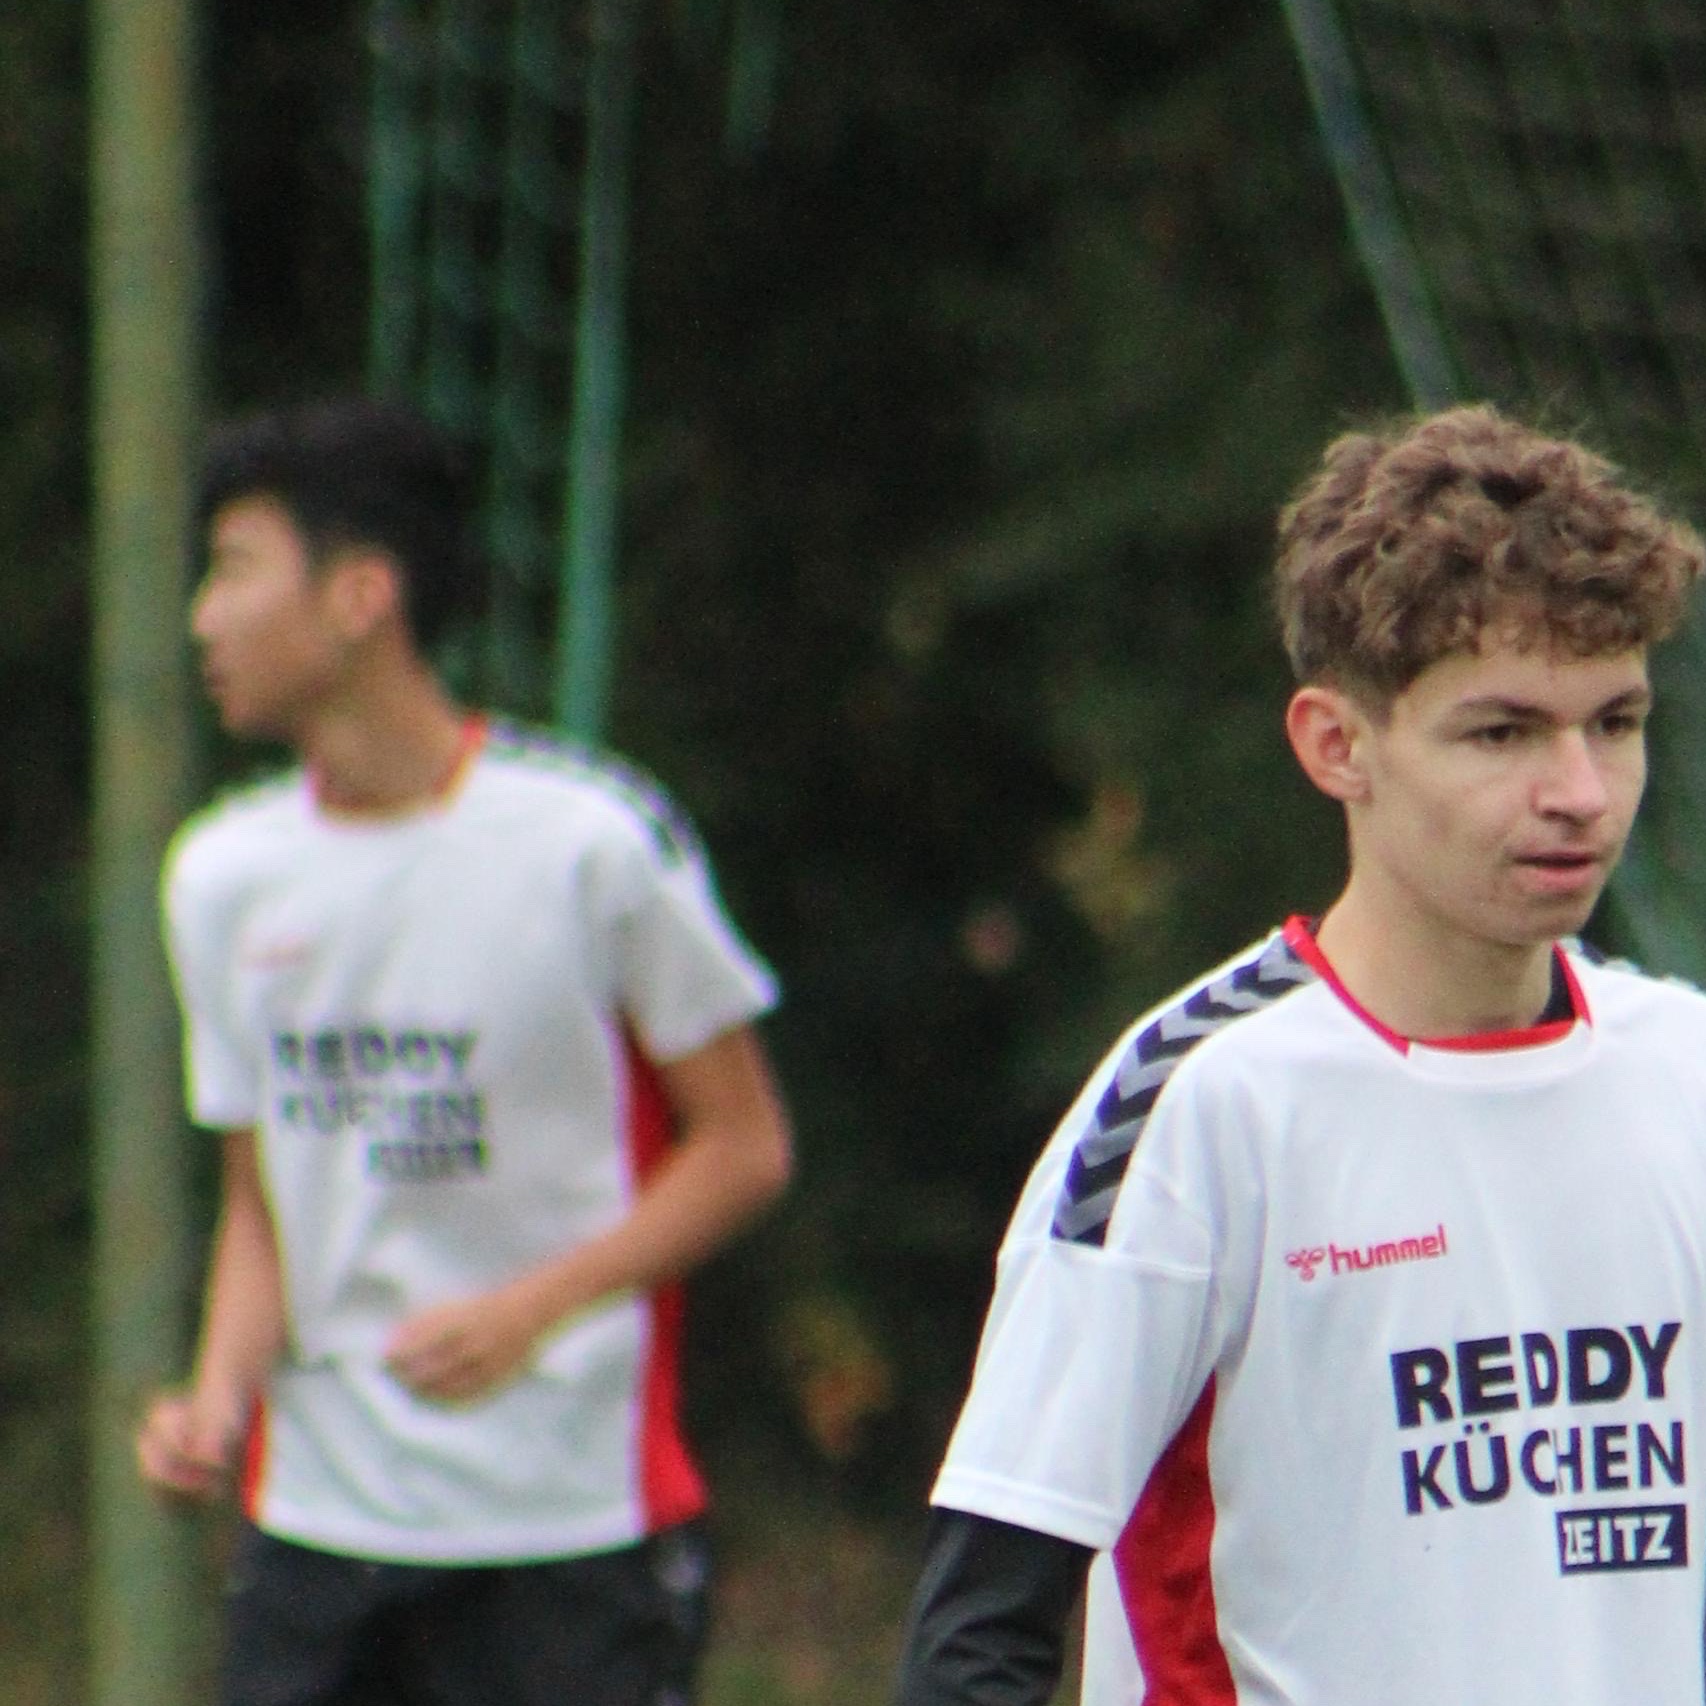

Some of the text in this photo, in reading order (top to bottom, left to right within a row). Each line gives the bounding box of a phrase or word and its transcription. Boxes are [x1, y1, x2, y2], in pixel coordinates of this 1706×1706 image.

[1328, 1223, 1448, 1276] hummel
[1390, 1322, 1682, 1430] REDDY
[1401, 1421, 1687, 1516] KÜCHEN
